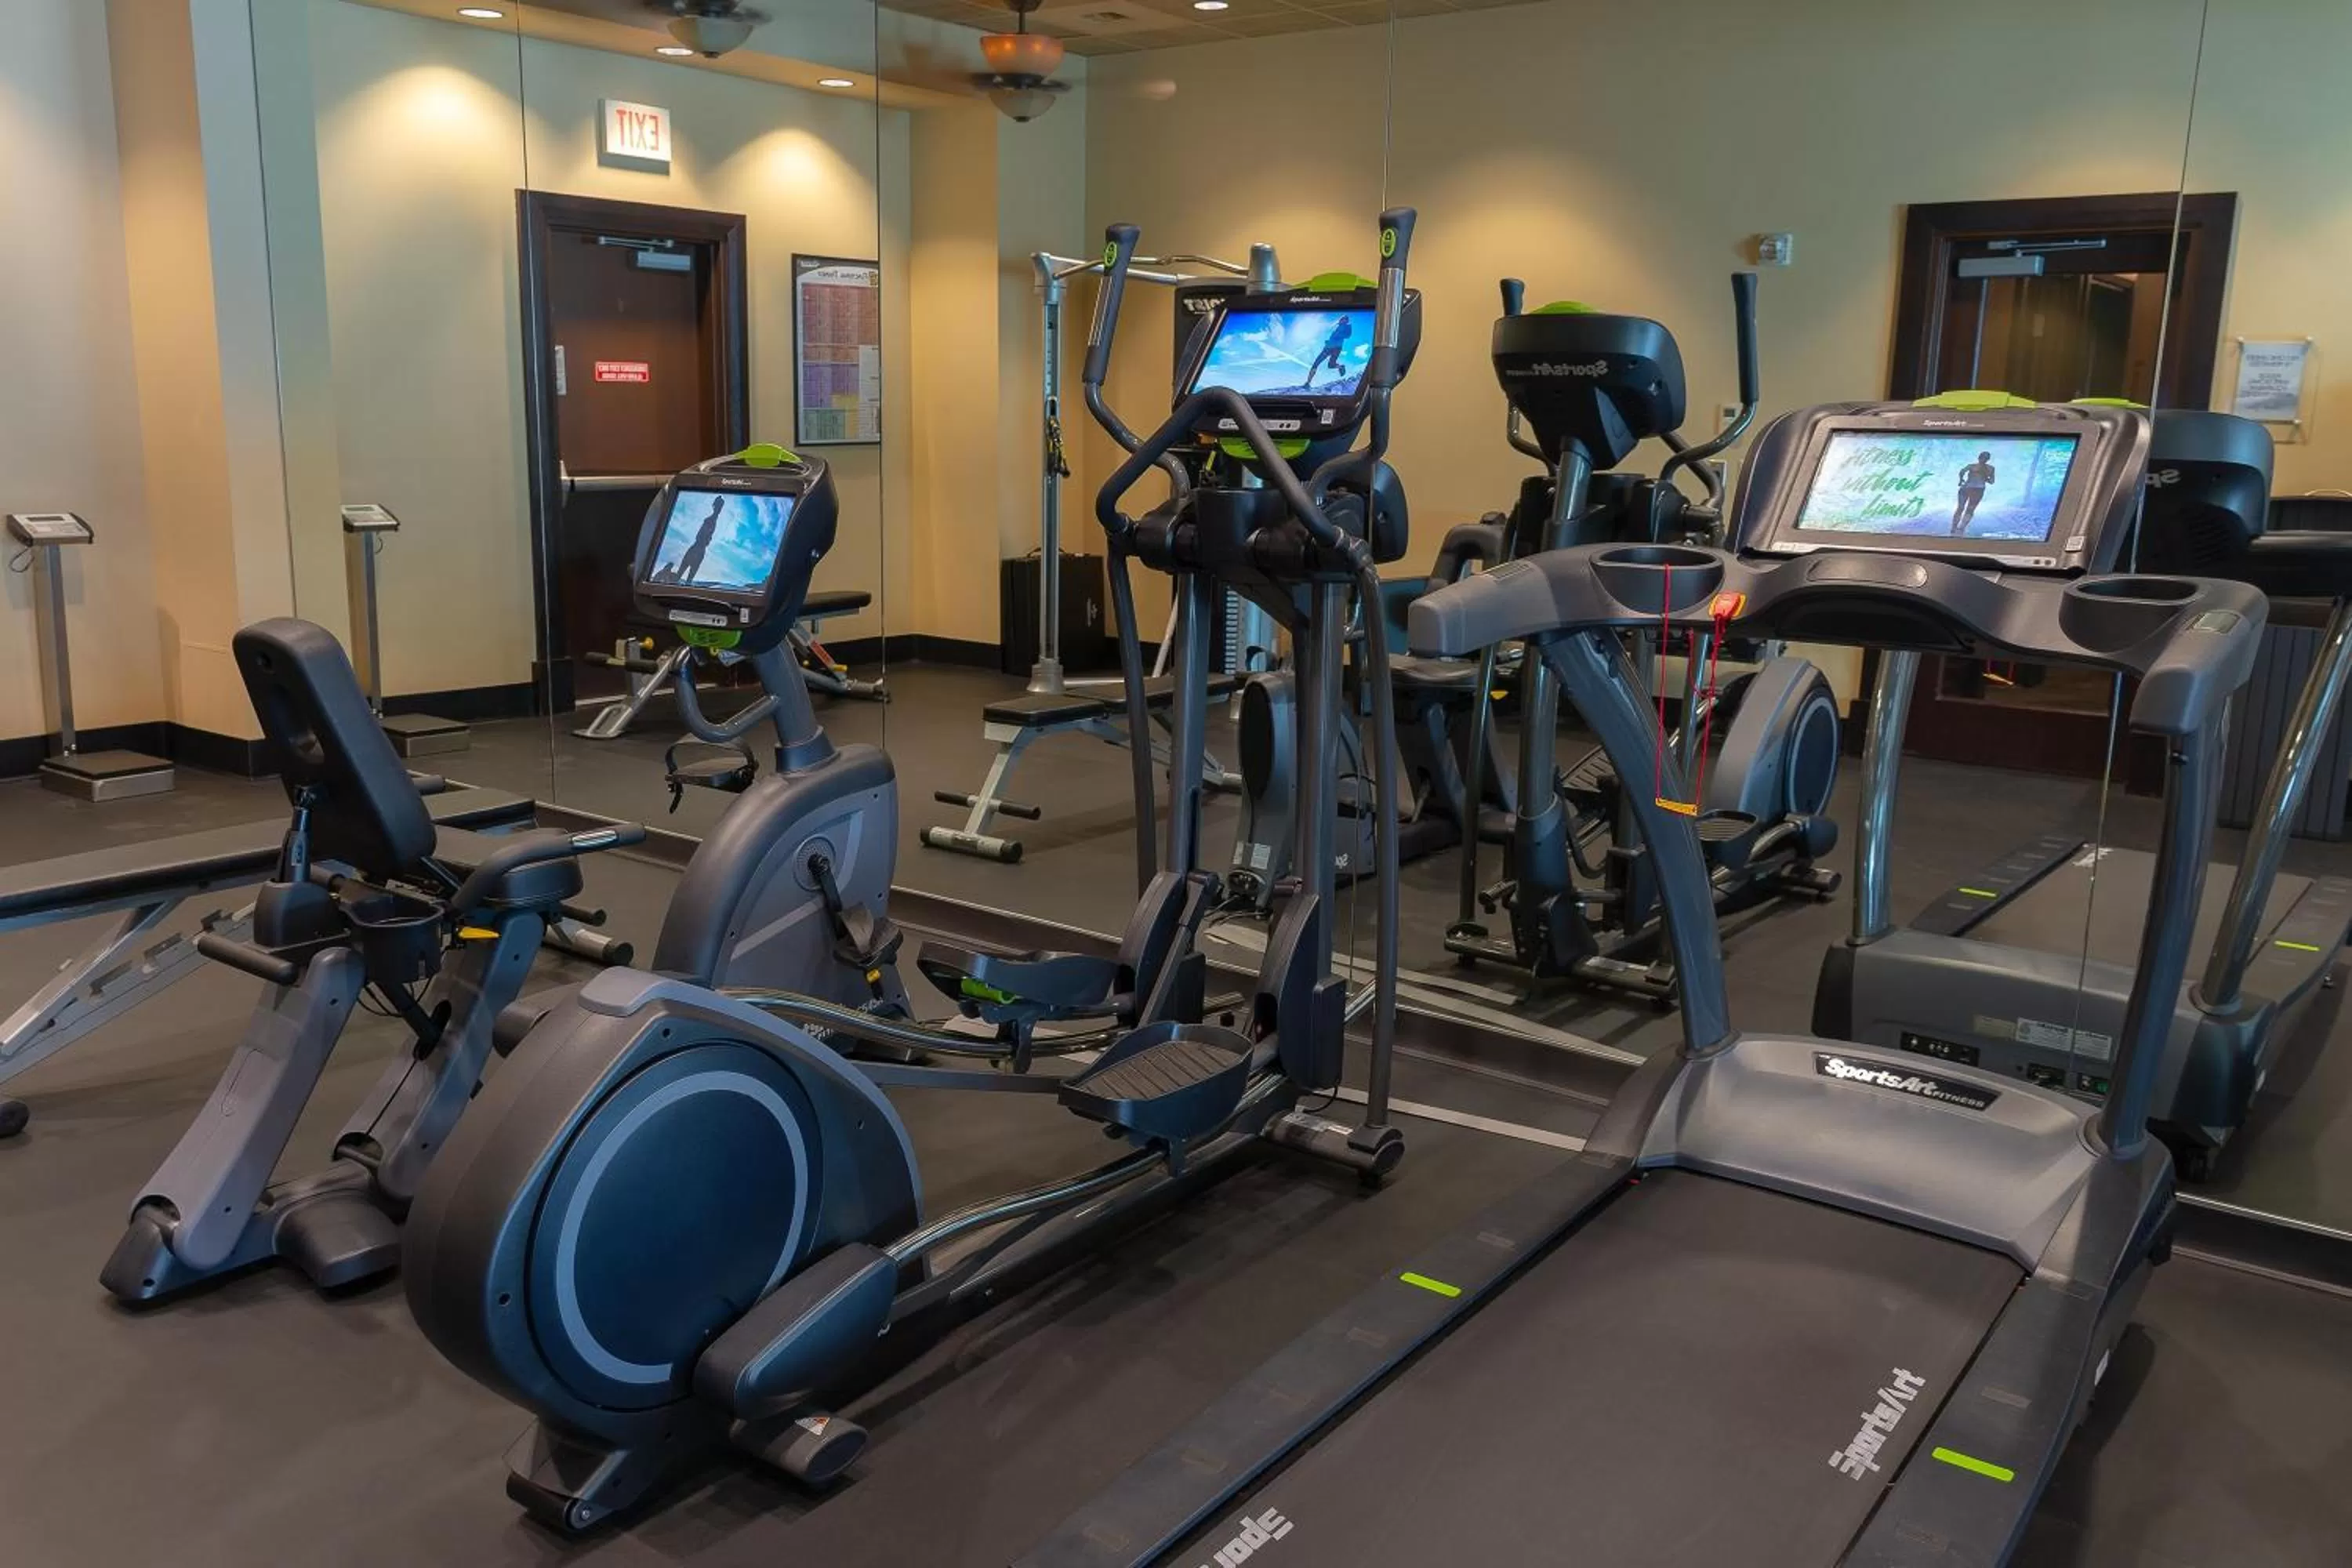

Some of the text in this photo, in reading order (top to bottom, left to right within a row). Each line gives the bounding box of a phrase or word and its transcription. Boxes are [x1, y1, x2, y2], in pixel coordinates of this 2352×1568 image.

[1824, 1058, 1986, 1108] SportsArt FITNESS
[1828, 1367, 1926, 1481] SportsArt
